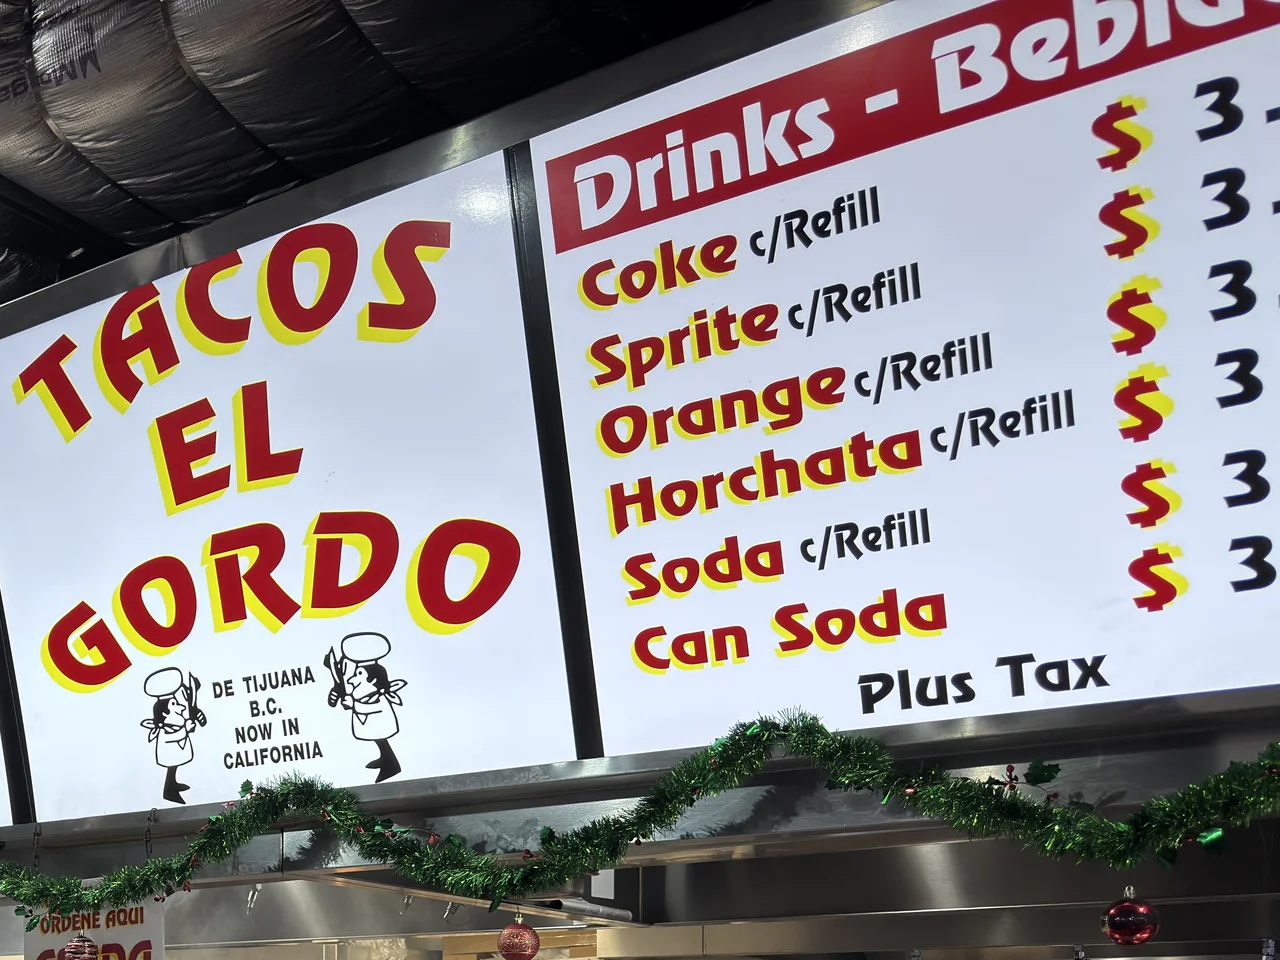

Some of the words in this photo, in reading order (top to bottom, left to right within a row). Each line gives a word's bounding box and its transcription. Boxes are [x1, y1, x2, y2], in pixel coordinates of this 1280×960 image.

[573, 98, 835, 232] Drinks
[578, 230, 738, 311] Coke
[749, 186, 881, 263] c/Refill
[12, 220, 451, 443] TACOS
[586, 297, 780, 392] Sprite
[787, 262, 922, 337] c/Refill
[147, 380, 304, 516] EL
[596, 365, 847, 458] Orange
[854, 332, 993, 404] c/Refill
[606, 428, 921, 538] Horchata
[930, 389, 1075, 461] c/Refill
[40, 510, 521, 693] GORDO
[621, 535, 785, 606] Soda
[799, 507, 931, 571] c/Refill
[212, 680, 234, 699] DE
[242, 666, 315, 693] TIJUANA
[631, 622, 750, 675] Can
[771, 588, 948, 660] Soda
[857, 668, 975, 715] Plus
[995, 652, 1110, 699] Tax
[223, 741, 323, 770] CALIFORNIA
[235, 723, 273, 744] NOW
[282, 718, 300, 736] IN
[249, 698, 282, 717] B.C.
[40, 911, 101, 936] ORDENE
[104, 906, 144, 930] AQUI
